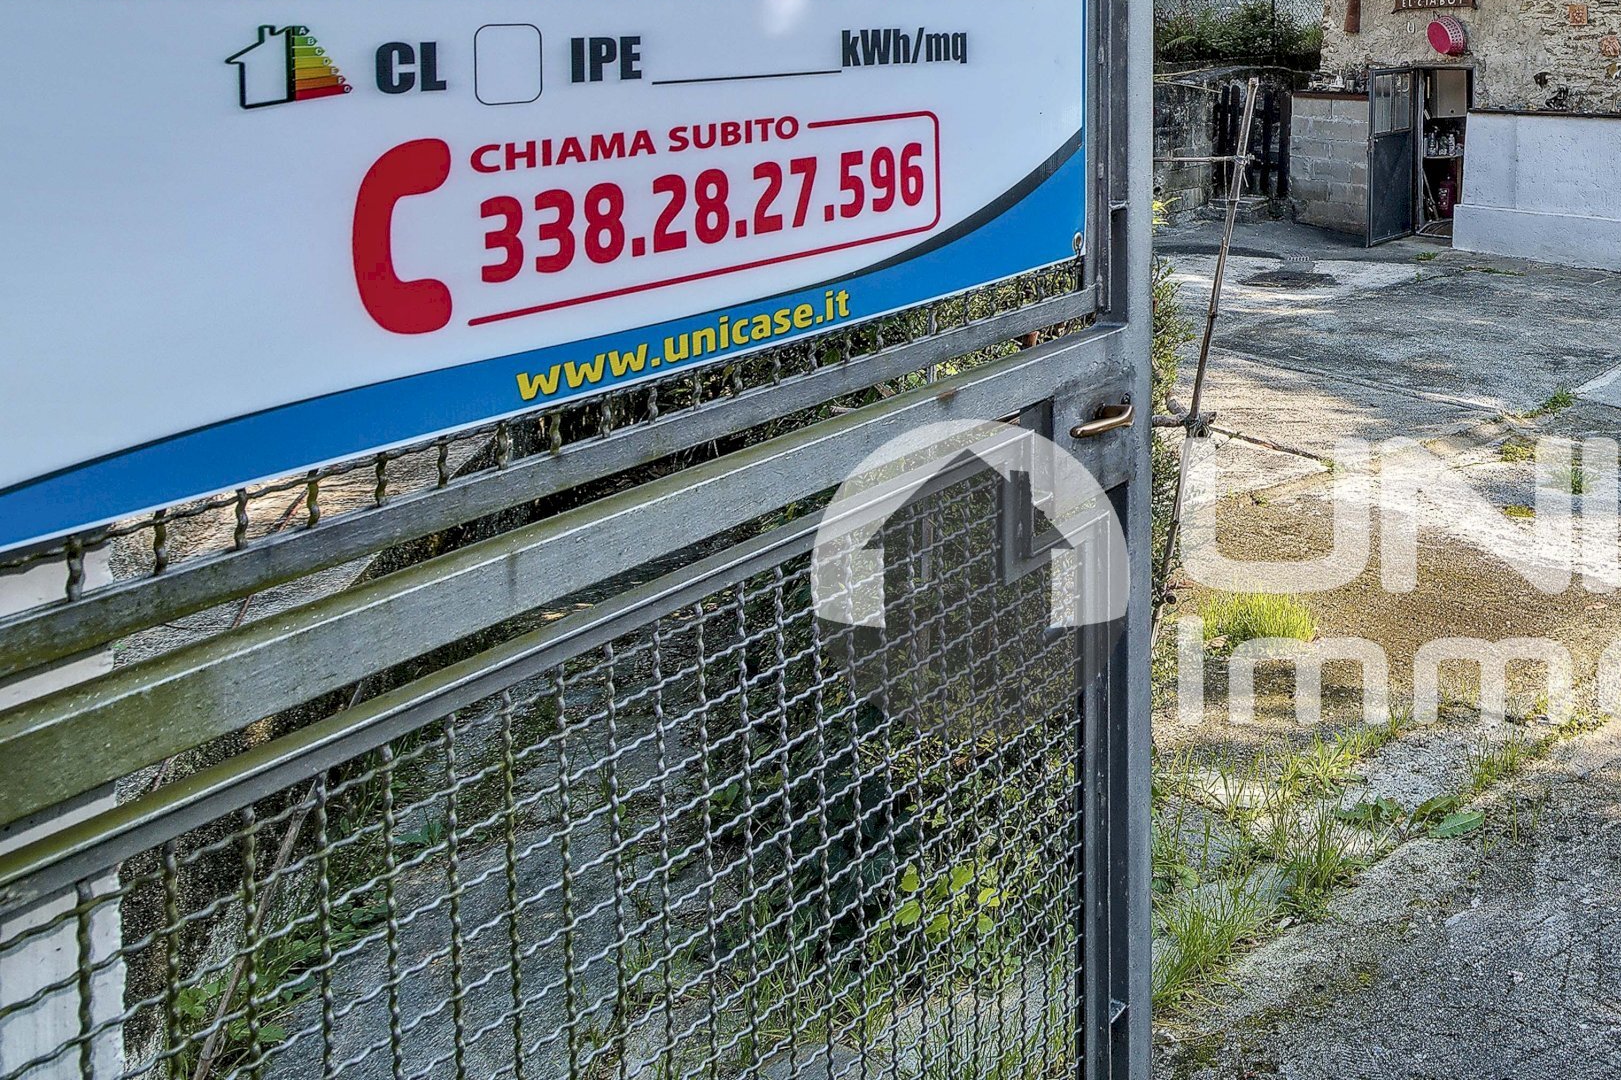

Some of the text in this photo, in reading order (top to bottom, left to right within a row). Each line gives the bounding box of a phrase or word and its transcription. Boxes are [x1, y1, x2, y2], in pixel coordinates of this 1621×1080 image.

[375, 27, 967, 94] CL IPE kWh/mq
[470, 116, 799, 173] CHIAMA SUBITO
[480, 142, 924, 283] 338.28.27.596
[516, 289, 850, 401] www.unicase.it
